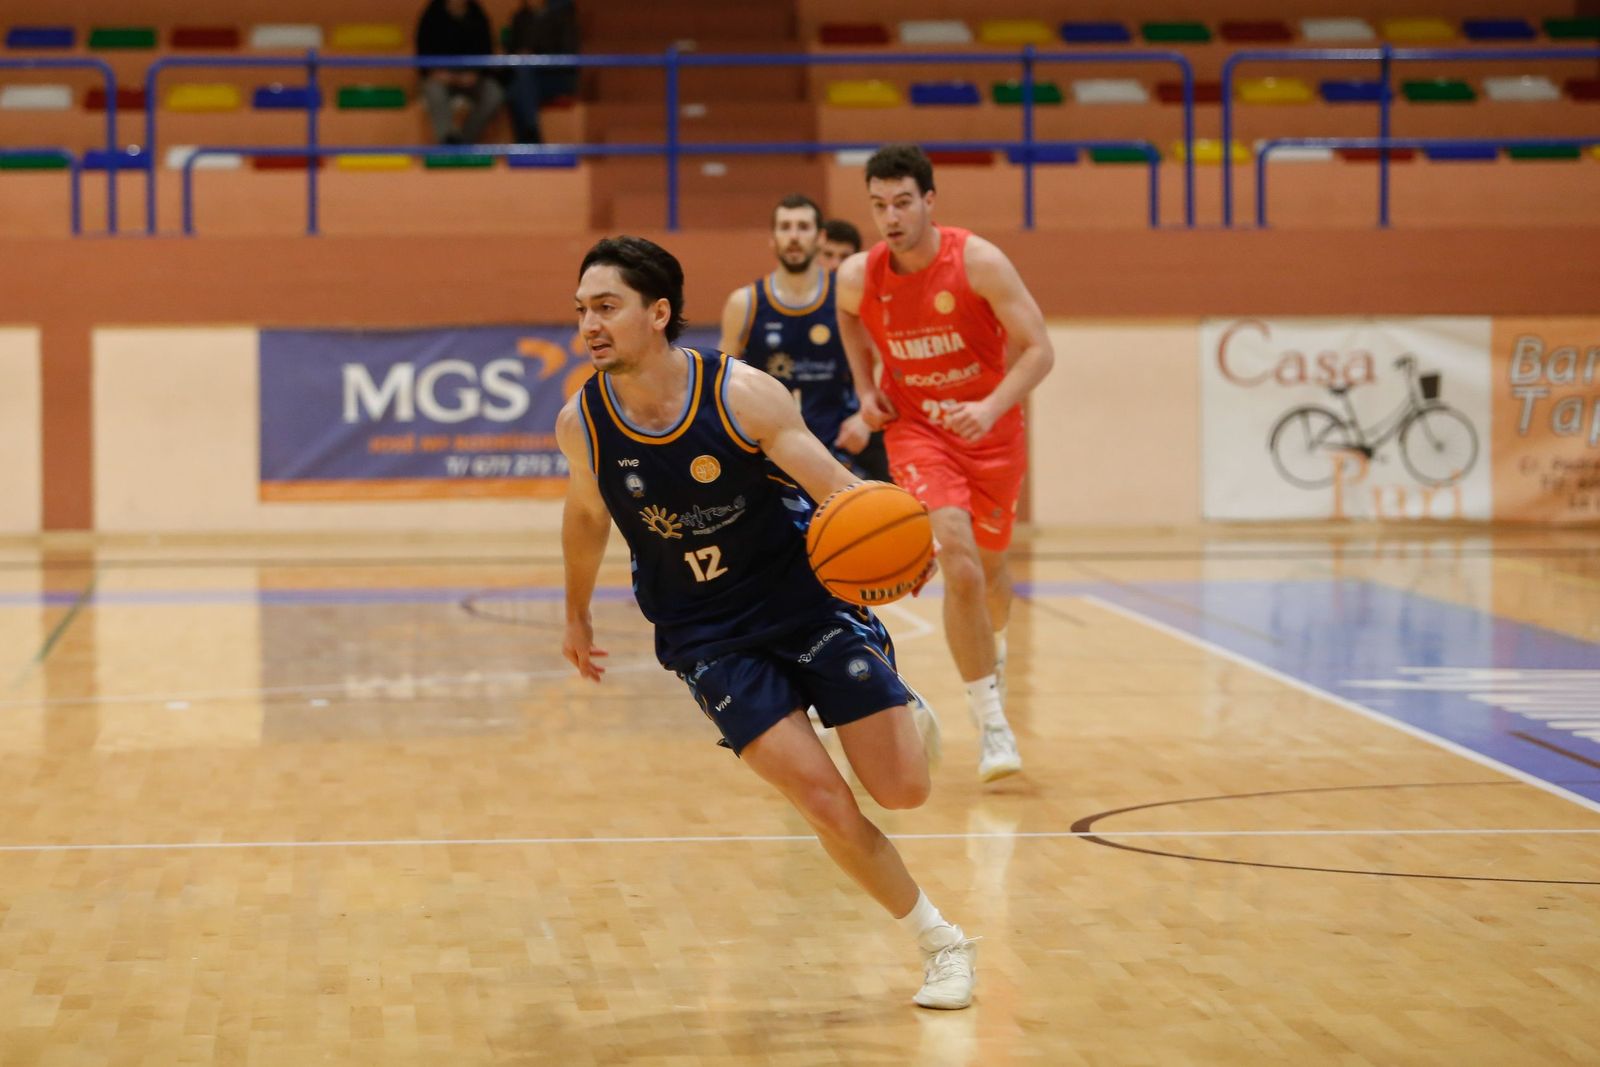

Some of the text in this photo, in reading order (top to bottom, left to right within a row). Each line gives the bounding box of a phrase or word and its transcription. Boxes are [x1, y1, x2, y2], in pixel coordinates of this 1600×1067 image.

[1215, 317, 1377, 388] Casa
[341, 358, 531, 424] MGS
[617, 457, 640, 468] vive
[1328, 448, 1466, 520] Puri
[684, 545, 729, 583] 12
[715, 694, 732, 712] vive
